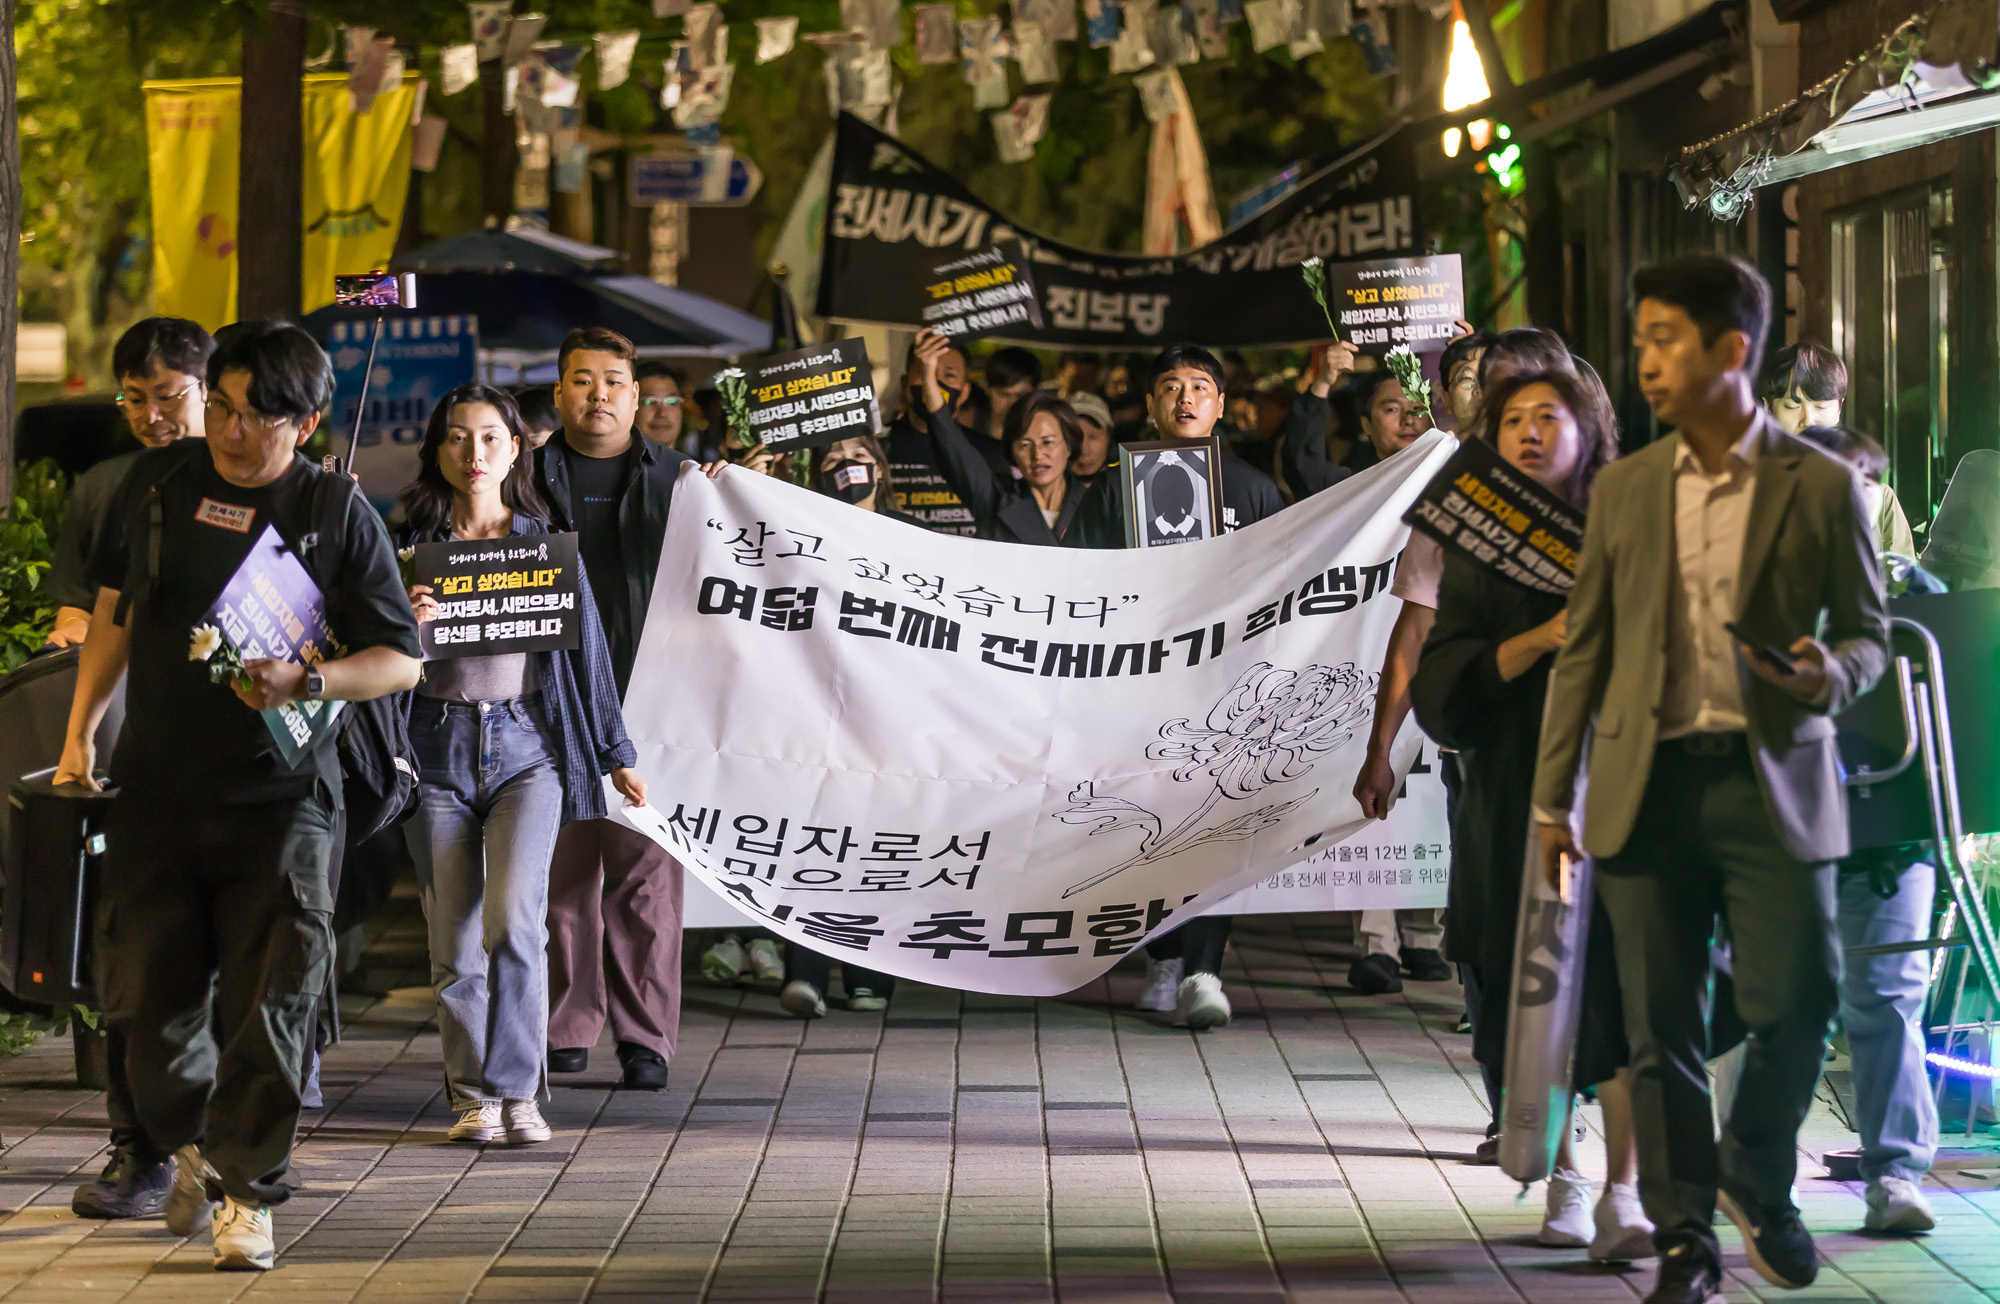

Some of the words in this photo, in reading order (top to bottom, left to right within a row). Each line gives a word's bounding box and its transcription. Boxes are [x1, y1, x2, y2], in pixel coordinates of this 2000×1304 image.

[833, 183, 991, 249] 전세사기
[1047, 285, 1170, 336] 진보당
[1347, 288, 1379, 304] "살고
[1382, 282, 1450, 302] 싶었습니다"
[1341, 306, 1403, 325] 세입자로서,
[1403, 302, 1461, 321] 시민으로서
[1350, 327, 1389, 344] 당신을
[1391, 323, 1454, 342] 추모합니다
[751, 384, 785, 403] "살고
[785, 366, 857, 397] 싶었습니다"
[811, 385, 873, 411] 시민으로서
[760, 423, 800, 445] 당신을
[801, 407, 867, 435] 추모합니다
[1416, 500, 1458, 536] 지금
[1441, 490, 1520, 554] 전세사기
[707, 518, 827, 567] “살고
[434, 575, 474, 595] "살고
[477, 568, 562, 592] 싶었습니다"
[216, 603, 250, 645] 지금
[252, 571, 306, 645] 세입자를
[433, 598, 499, 620] 입자로서,
[500, 593, 574, 614] 시민으로서
[240, 592, 293, 661] 전세사기
[434, 624, 481, 645] 당신을
[484, 618, 563, 641] 추모합니다
[697, 576, 819, 631] 여덟
[838, 591, 961, 652] 번째
[980, 621, 1226, 678] 전세사기
[667, 803, 991, 863] 세입자로서
[1323, 846, 1369, 863] 서울역
[1374, 844, 1408, 861] 12번
[1412, 843, 1444, 860] 출구
[1331, 869, 1363, 886] 문제
[1367, 869, 1413, 886] 해결을
[1418, 867, 1448, 884] 위한
